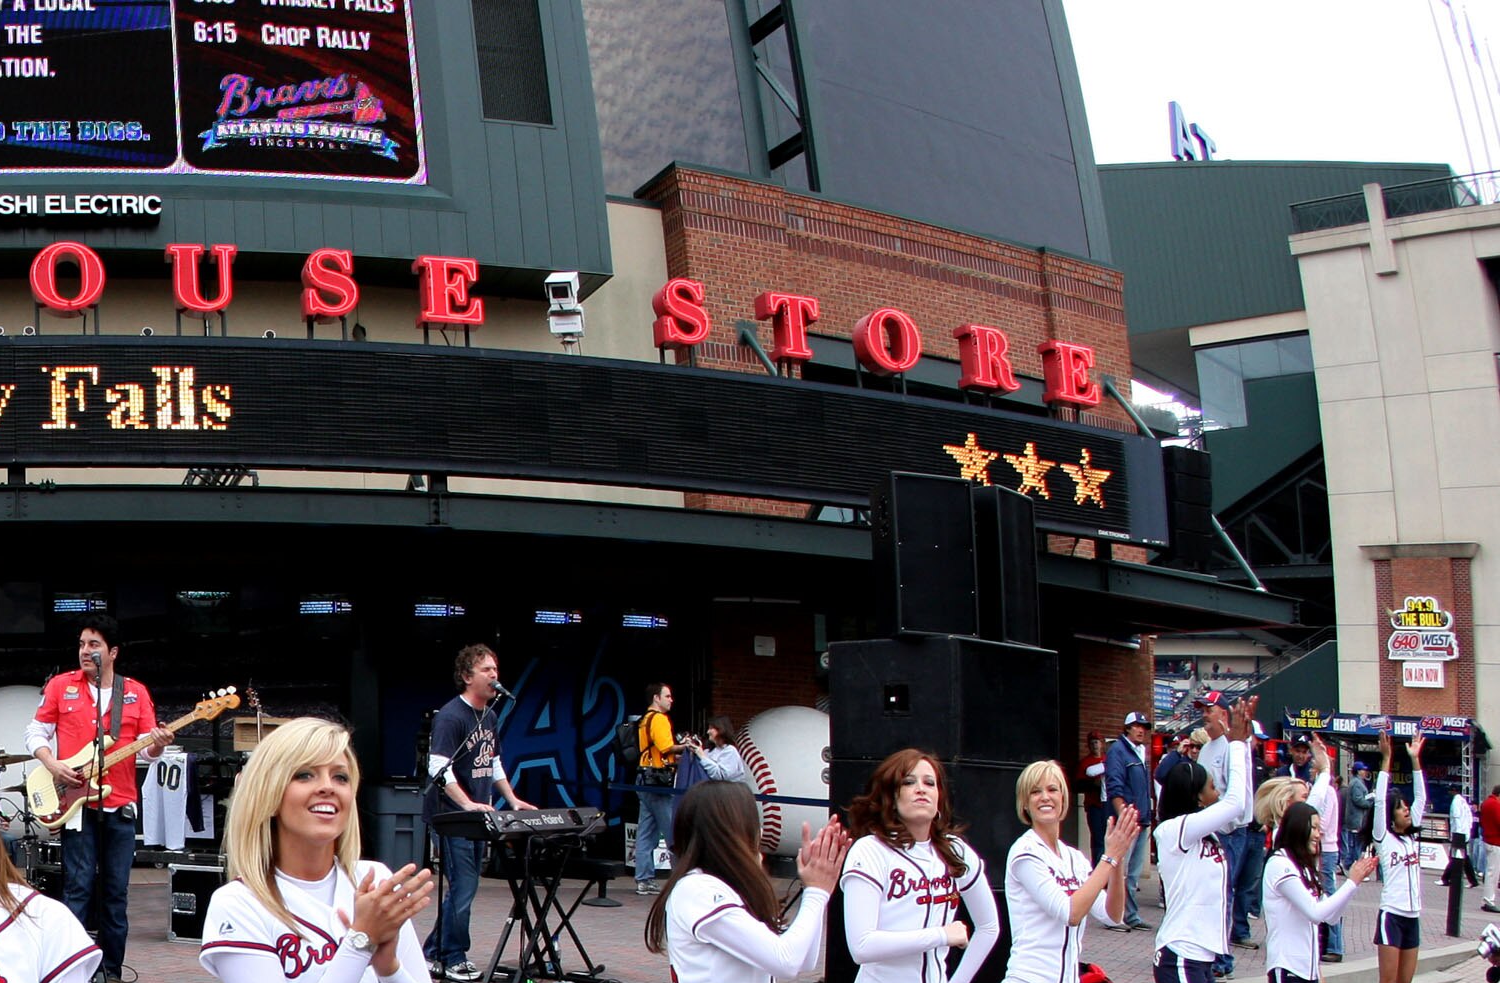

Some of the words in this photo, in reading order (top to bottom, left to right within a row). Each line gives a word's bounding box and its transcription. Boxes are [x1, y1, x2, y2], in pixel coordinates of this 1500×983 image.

[4, 24, 43, 44] THE
[193, 21, 237, 43] 6:15
[261, 23, 310, 46] CHOP
[317, 26, 370, 51] RALLY
[215, 73, 350, 118] Braves
[12, 120, 71, 141] THE
[77, 120, 150, 142] BIGS.
[45, 194, 162, 215] ELECTRIC
[652, 277, 1101, 410] STORE
[41, 365, 234, 431] Falls
[1407, 599, 1434, 611] 94.9
[1400, 613, 1417, 626] THE
[1420, 613, 1441, 626] BULL
[1392, 635, 1419, 649] 640
[1422, 635, 1450, 645] WGST
[1404, 668, 1413, 682] ON
[1414, 668, 1424, 682] AIR
[1425, 668, 1438, 682] NOW
[1333, 718, 1357, 731] HEAR
[1394, 721, 1417, 735] HERE
[1421, 717, 1441, 728] 640
[1443, 717, 1467, 727] WGST
[157, 761, 181, 790] 00
[541, 814, 564, 824] Roland
